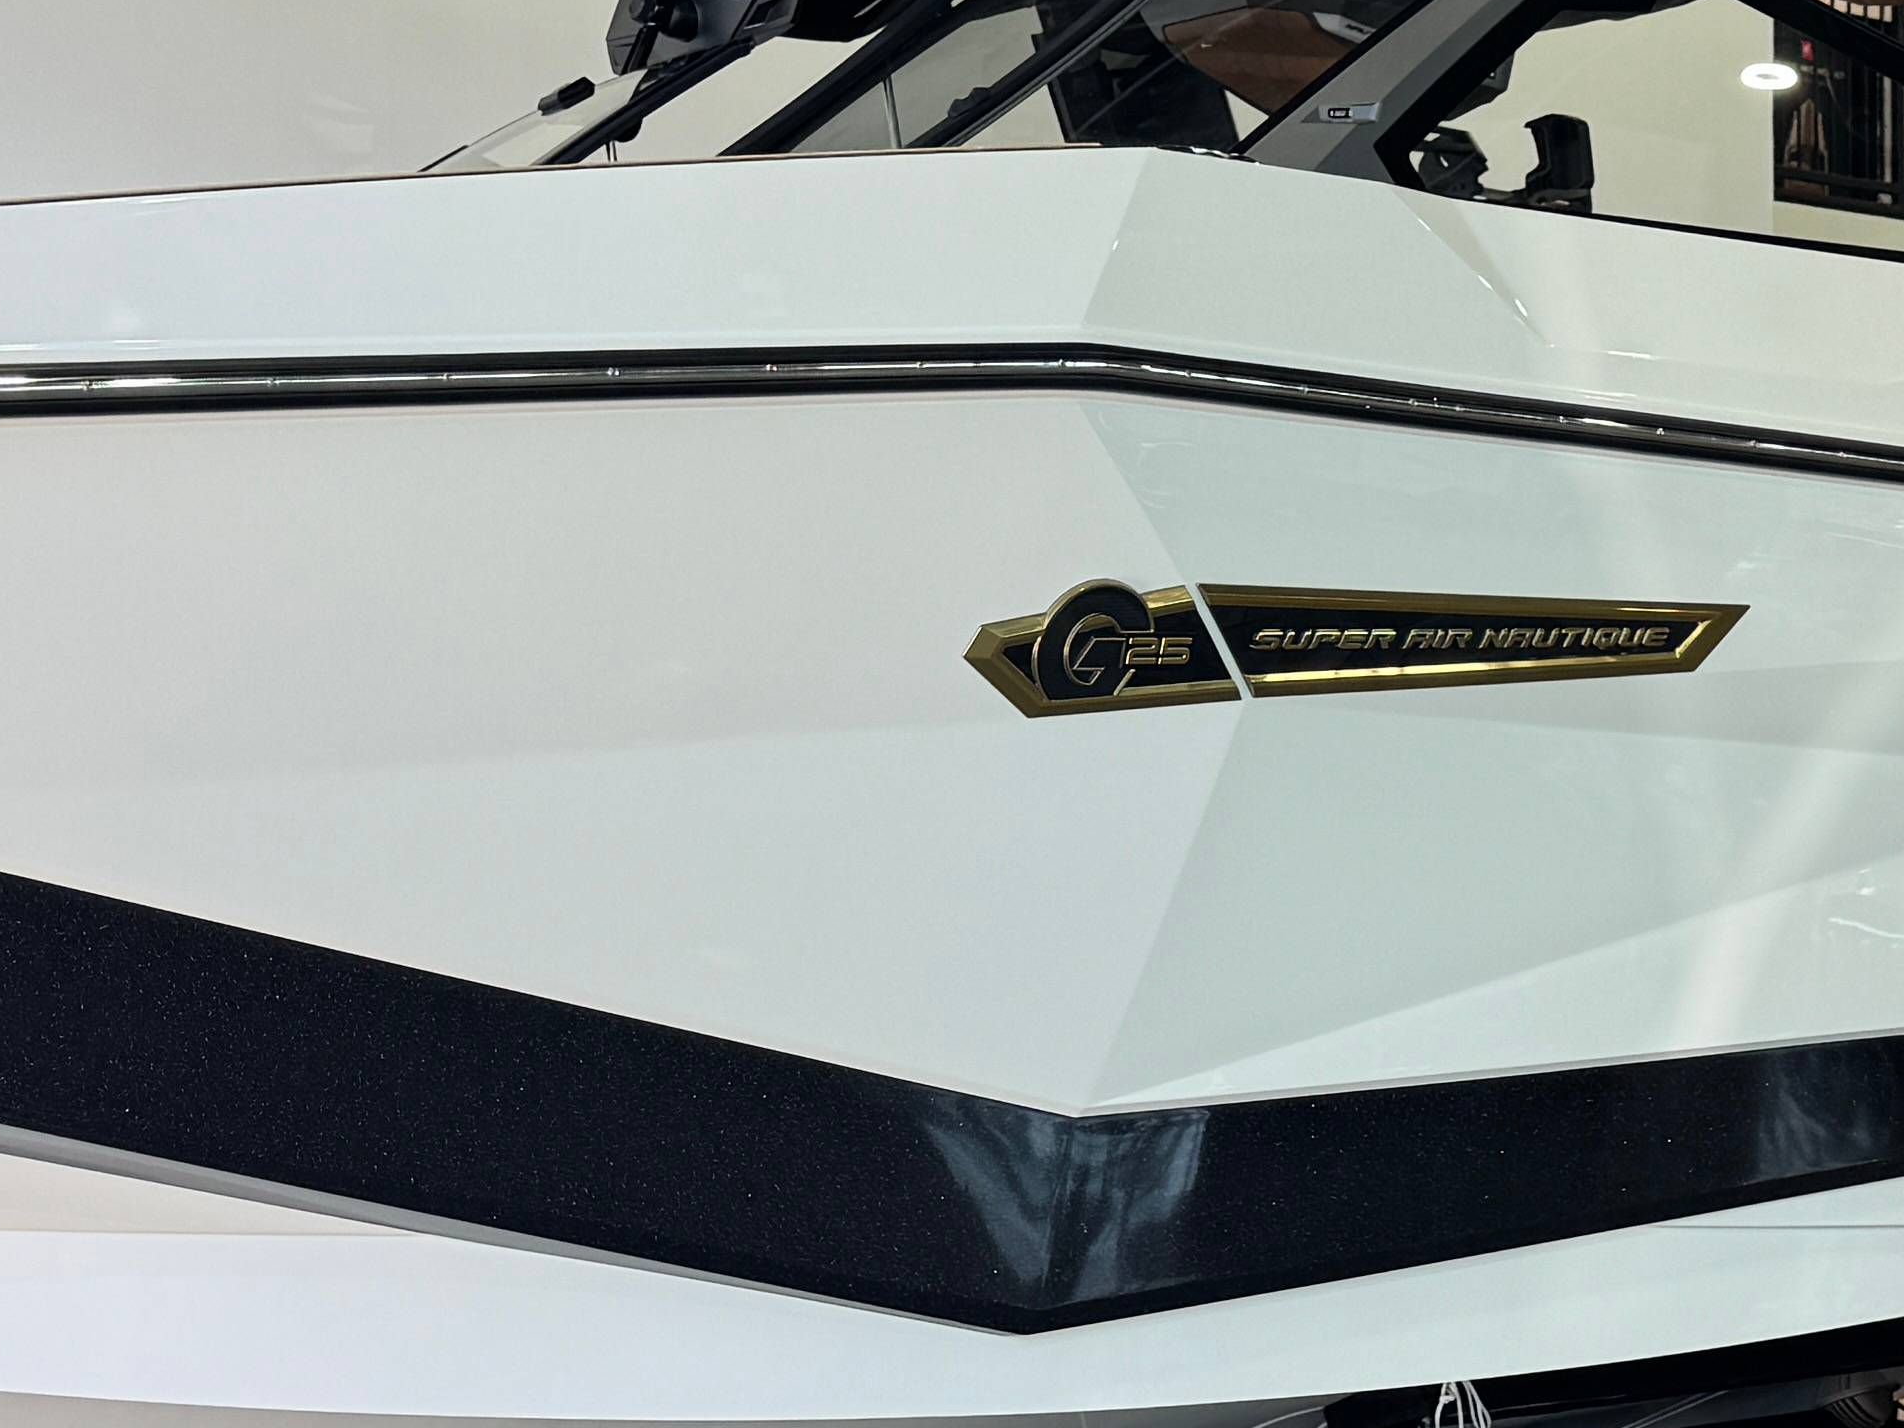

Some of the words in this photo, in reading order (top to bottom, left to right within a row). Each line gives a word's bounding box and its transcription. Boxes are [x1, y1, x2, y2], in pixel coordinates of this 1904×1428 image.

[1248, 627, 1397, 651] SUPER
[1402, 627, 1473, 651] AIR
[1478, 625, 1672, 650] NAUTIQUE
